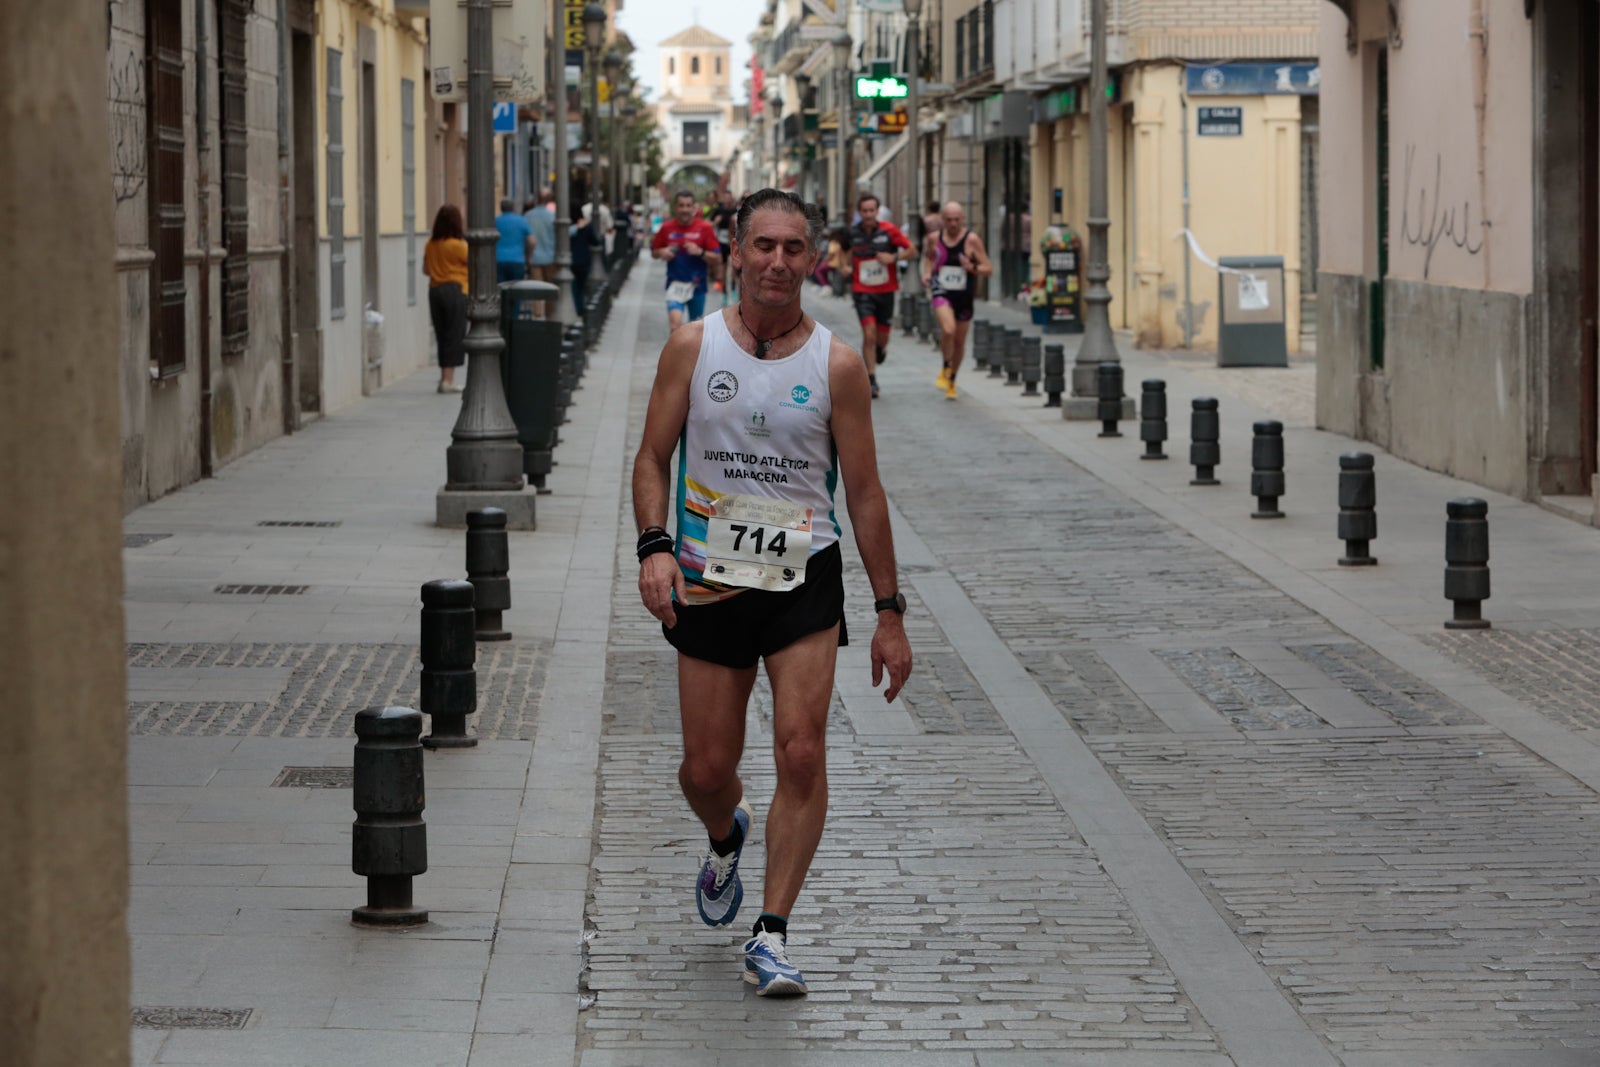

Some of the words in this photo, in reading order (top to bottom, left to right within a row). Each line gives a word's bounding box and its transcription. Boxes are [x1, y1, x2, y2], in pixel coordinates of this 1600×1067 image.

[791, 389, 809, 400] SIC
[778, 401, 819, 413] CONSULTORES
[704, 450, 758, 465] JUVENTUD
[760, 455, 809, 470] ATLÉTICA
[723, 468, 788, 484] MARACENA
[730, 524, 787, 557] 714
